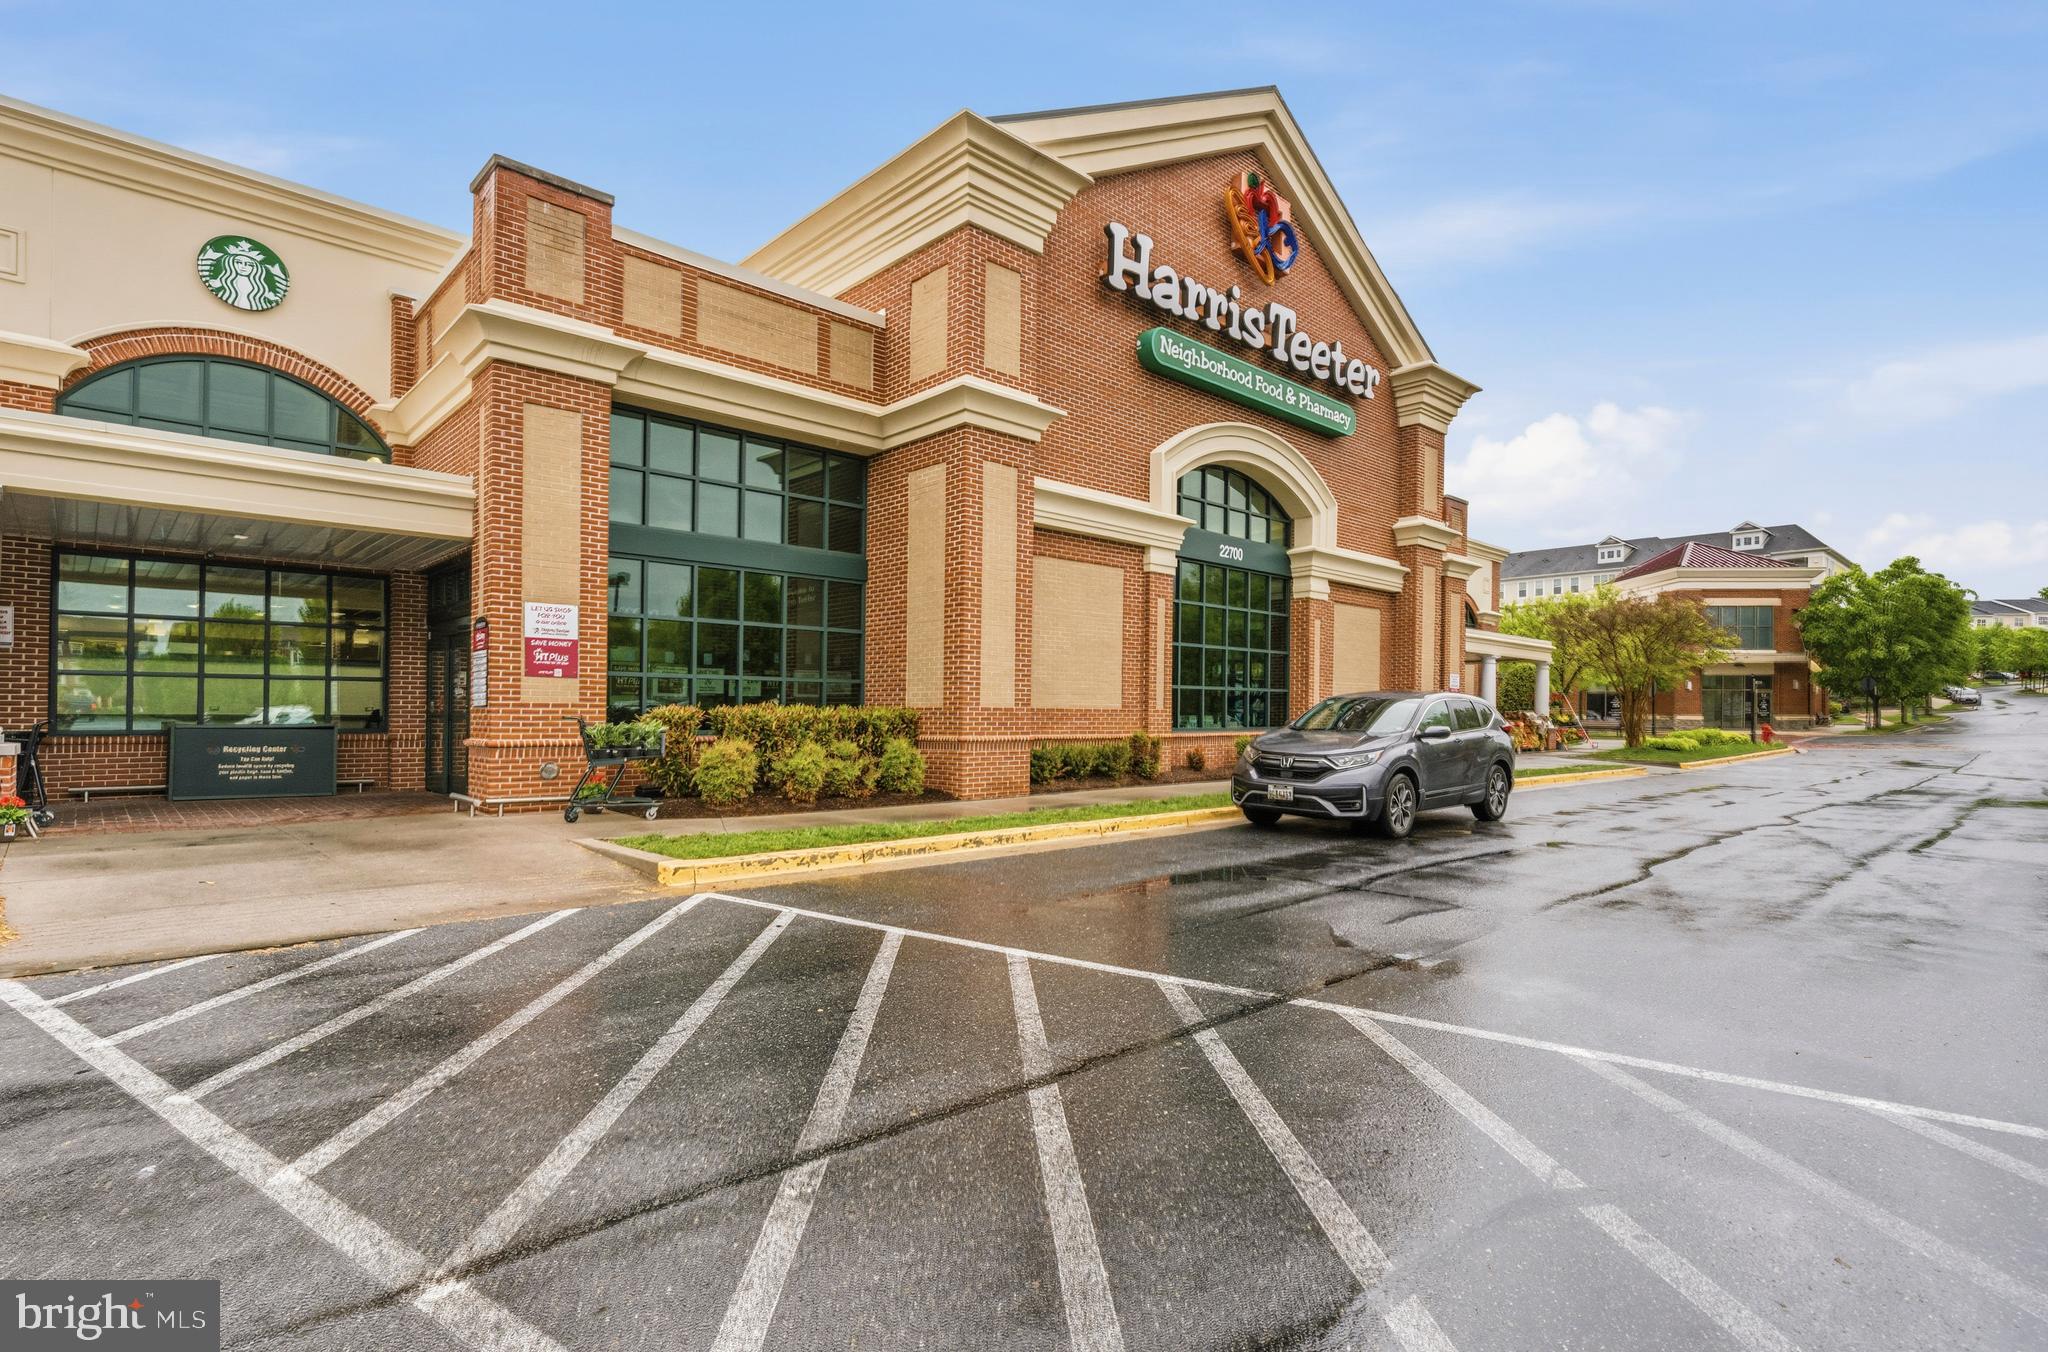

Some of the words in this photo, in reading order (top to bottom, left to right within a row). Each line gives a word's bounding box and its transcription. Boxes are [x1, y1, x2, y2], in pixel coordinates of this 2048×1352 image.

[1106, 222, 1265, 349] Harris
[1269, 302, 1380, 399] Teeter
[1160, 335, 1252, 389] Neighborhood
[1255, 375, 1283, 401] Food
[1286, 387, 1296, 405] &
[1299, 393, 1351, 430] Pharmacy
[1219, 544, 1244, 561] 22700
[548, 653, 569, 662] Plus
[223, 745, 260, 754] Recycling
